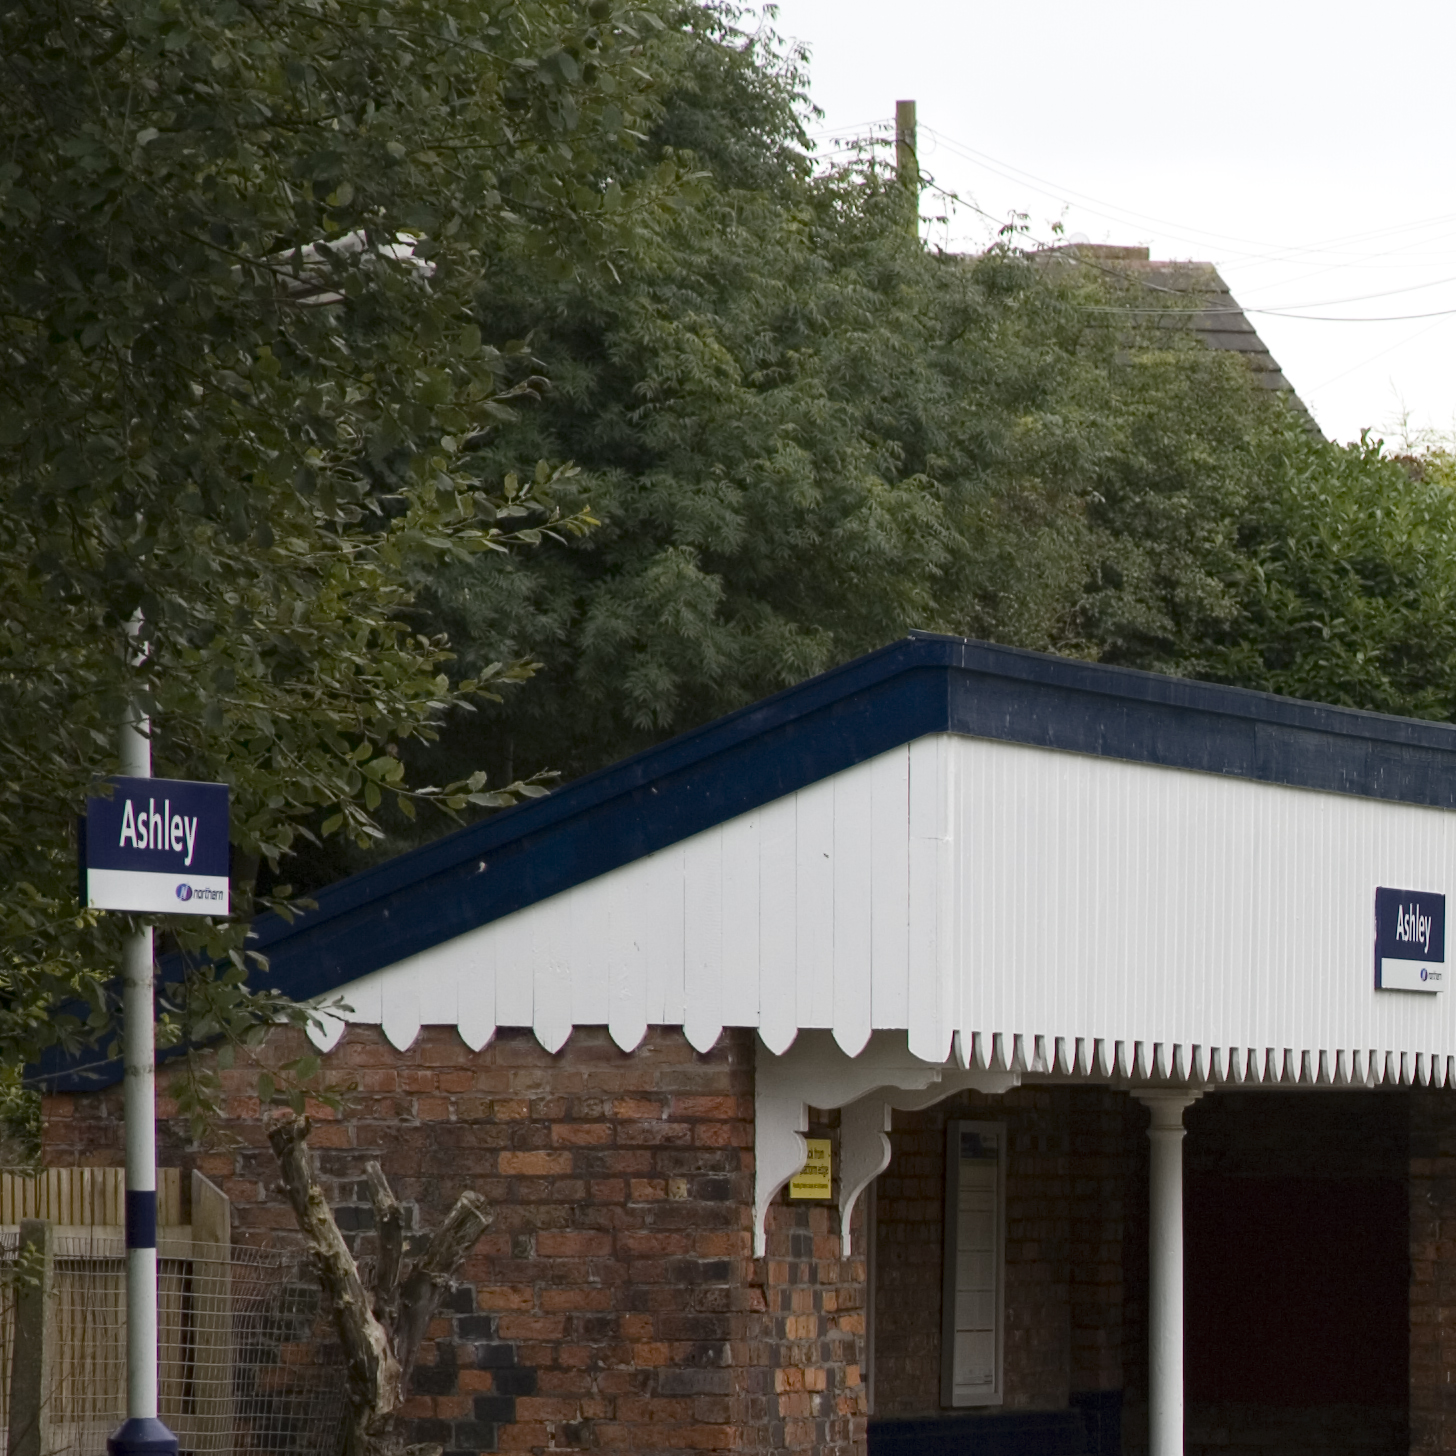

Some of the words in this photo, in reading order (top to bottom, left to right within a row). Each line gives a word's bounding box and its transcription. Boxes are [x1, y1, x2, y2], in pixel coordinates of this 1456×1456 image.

[119, 798, 198, 867] Ashley
[193, 886, 223, 900] northern
[1396, 903, 1432, 954] Ashley
